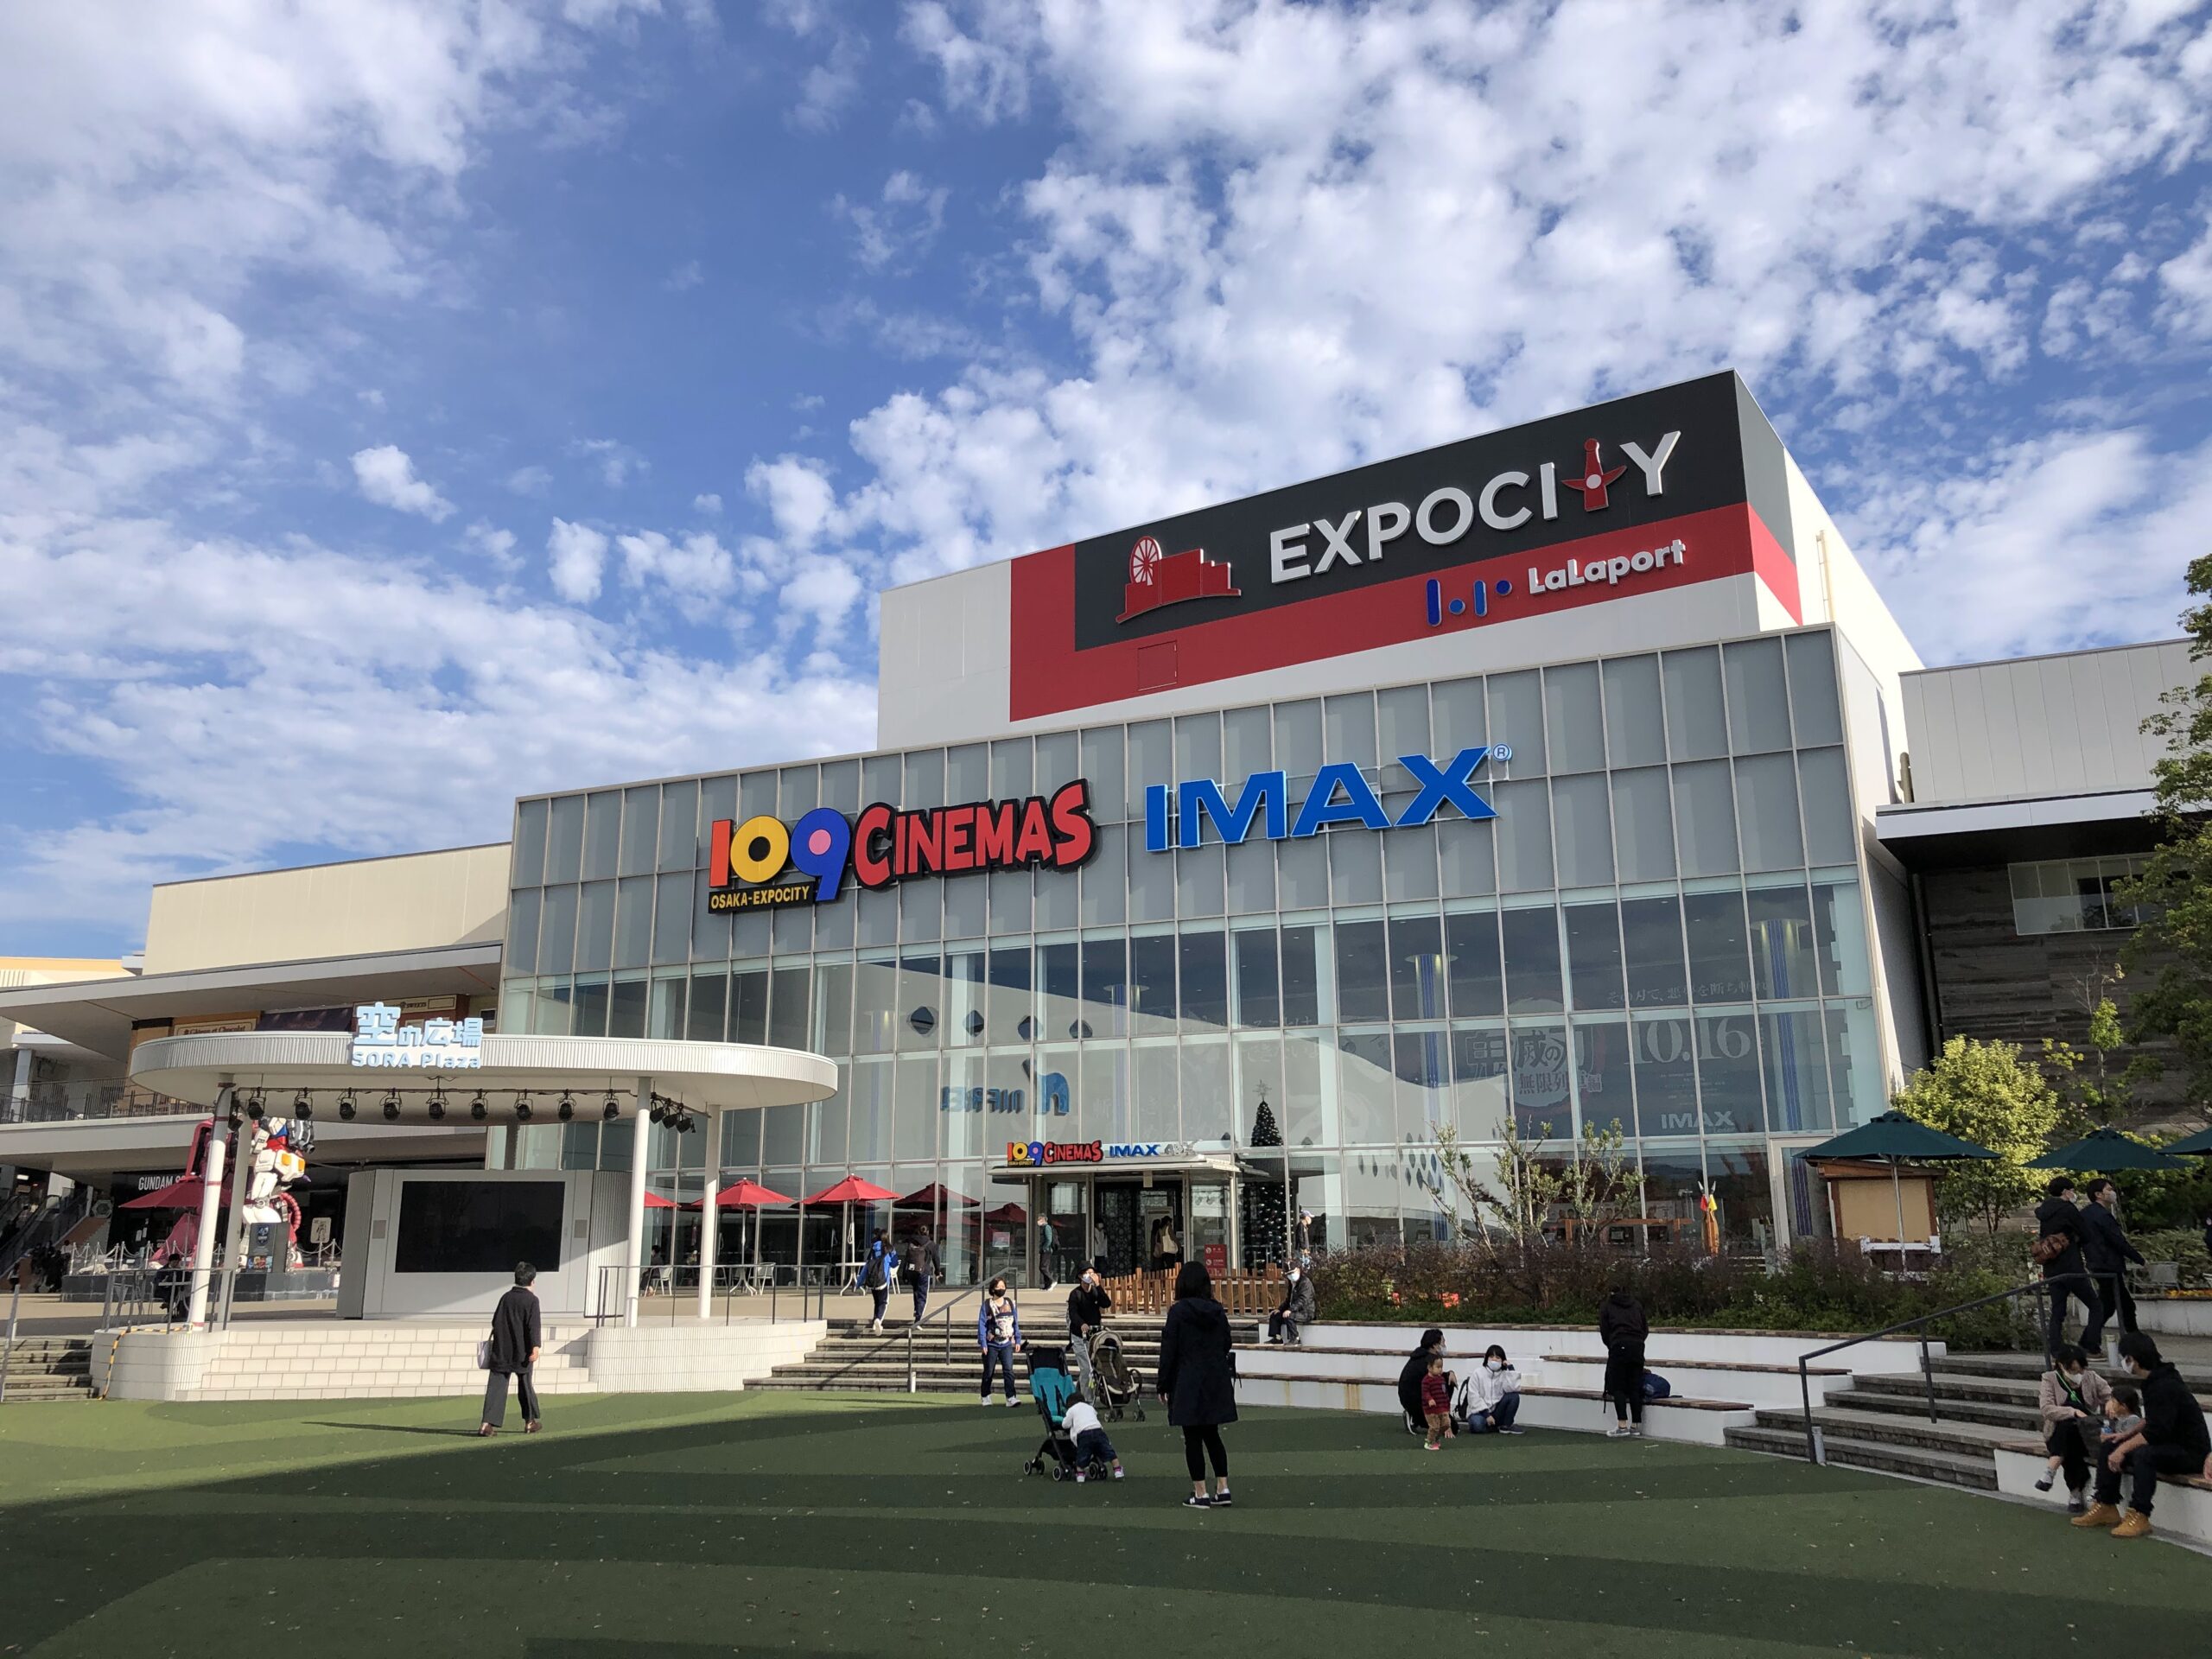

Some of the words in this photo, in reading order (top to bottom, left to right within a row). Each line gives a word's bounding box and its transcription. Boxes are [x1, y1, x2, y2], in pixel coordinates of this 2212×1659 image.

[1529, 539, 1686, 594] LaLaport
[709, 808, 850, 902] 109
[854, 780, 1094, 880] CINEMAS
[710, 886, 810, 909] OSAKA-EXPOCITY
[353, 1001, 483, 1047] 空の広場
[352, 1052, 413, 1068] SORA
[420, 1052, 481, 1069] Plaza
[1661, 1110, 1735, 1129] IMAX
[1007, 1141, 1045, 1166] 109
[1043, 1140, 1103, 1164] CINEMAS
[1109, 1143, 1160, 1158] IMAX
[138, 1176, 174, 1191] GUNDAM
